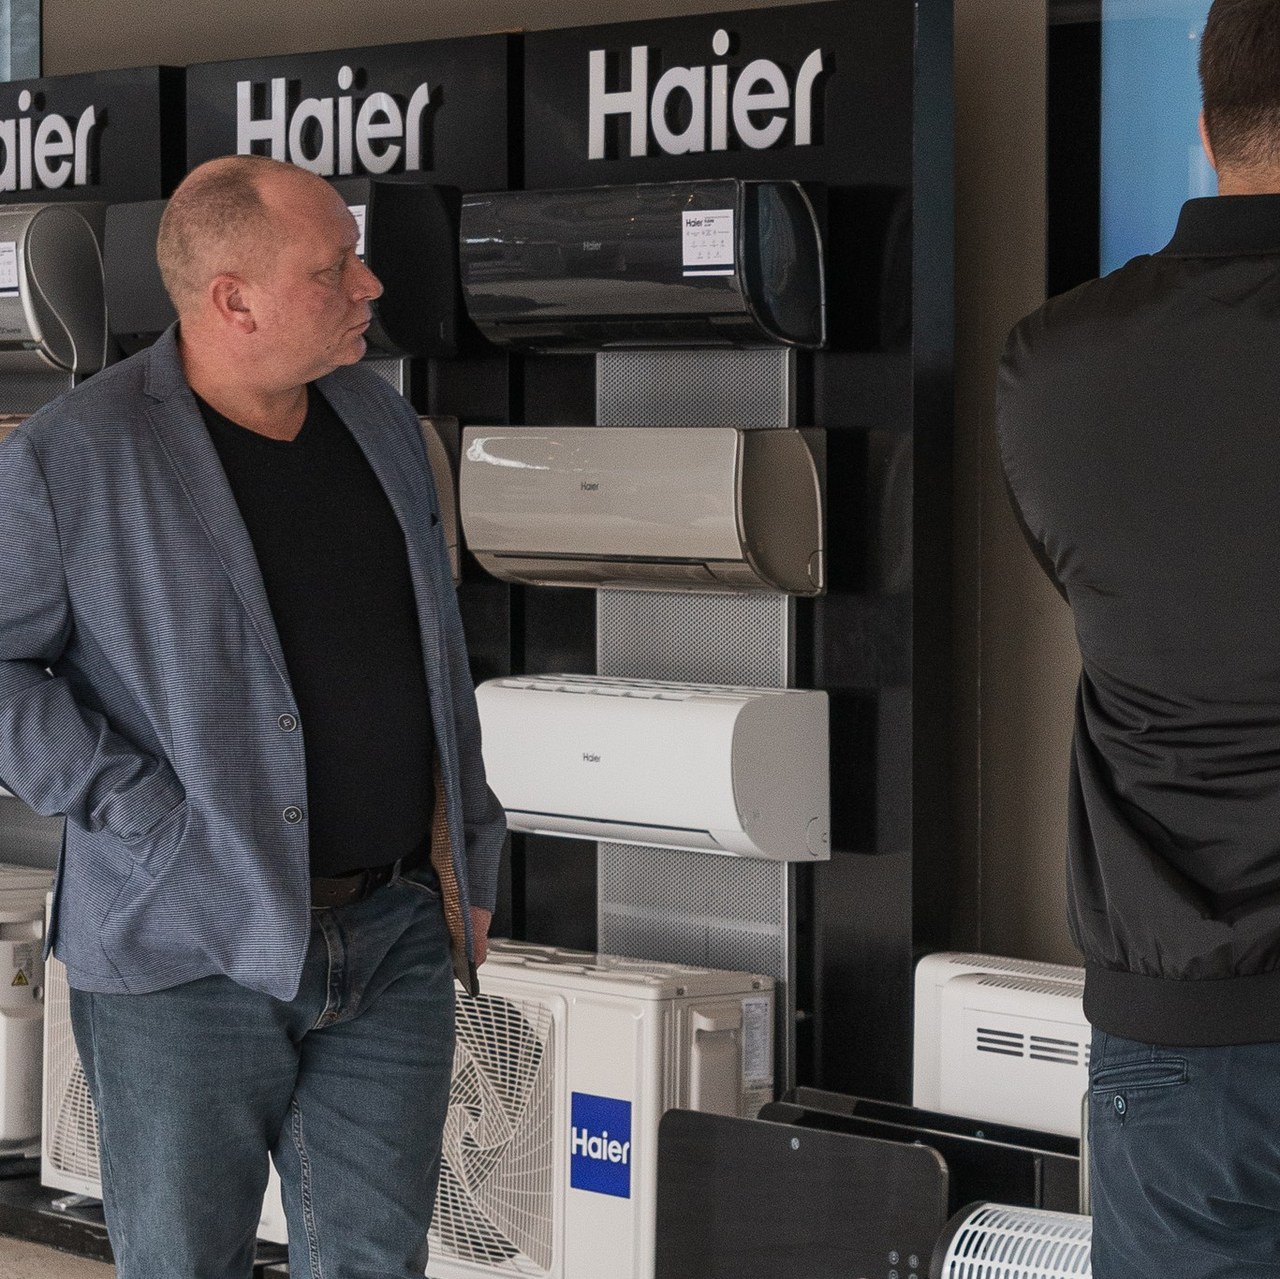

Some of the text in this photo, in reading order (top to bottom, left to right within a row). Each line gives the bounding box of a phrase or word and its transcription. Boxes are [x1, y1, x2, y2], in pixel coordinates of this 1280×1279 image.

[237, 65, 430, 176] Haier
[588, 28, 824, 160] Haier
[571, 1126, 630, 1164] Haier
